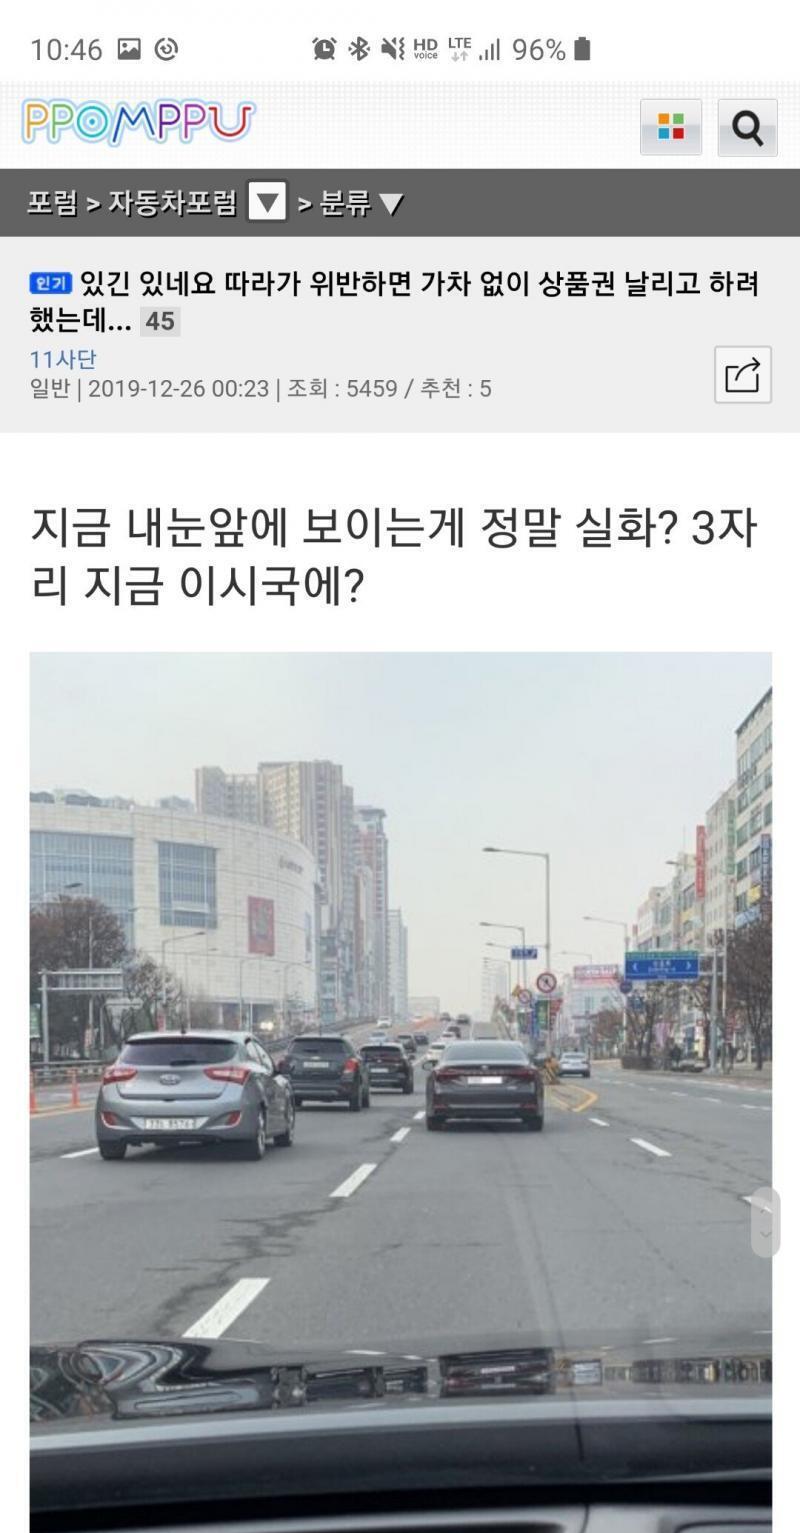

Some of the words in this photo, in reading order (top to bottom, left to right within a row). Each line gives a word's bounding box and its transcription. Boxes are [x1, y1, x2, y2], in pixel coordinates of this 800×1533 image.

[31, 39, 103, 61] 10:46
[413, 38, 438, 50] HD
[414, 51, 438, 60] voice
[448, 37, 472, 49] LTE
[513, 38, 566, 61] 96%
[24, 101, 253, 144] PPOMPPU
[27, 190, 78, 218] 포럼
[108, 190, 237, 218] 자동차포럼
[320, 191, 372, 218] 분류
[80, 270, 130, 297] 있긴
[139, 270, 217, 297] 있네요
[225, 270, 302, 297] 따라가
[309, 270, 411, 297] 위반하면
[420, 270, 472, 297] 가차
[480, 270, 529, 297] 없이
[538, 270, 615, 297] 상품권
[625, 270, 701, 297] 날리고
[709, 270, 758, 297] 하려
[29, 306, 132, 334] 했는데...
[145, 311, 175, 331] 45
[30, 349, 97, 371] 11사단
[30, 378, 71, 399] 일반
[88, 379, 206, 398] 2019-12-26
[212, 379, 269, 398] 00:23
[287, 378, 327, 399] 조회
[347, 379, 398, 398] 5459
[420, 378, 460, 399] 추천
[480, 379, 492, 398] 5
[31, 506, 111, 549] 지금
[128, 507, 286, 549] 내눈앞에
[302, 507, 464, 549] 보이는게
[481, 506, 562, 549] 정말
[575, 507, 678, 549] 실화?
[691, 506, 758, 549] 3자
[33, 565, 66, 607] 리
[84, 565, 164, 607] 지금
[180, 565, 365, 607] 이시국에?
